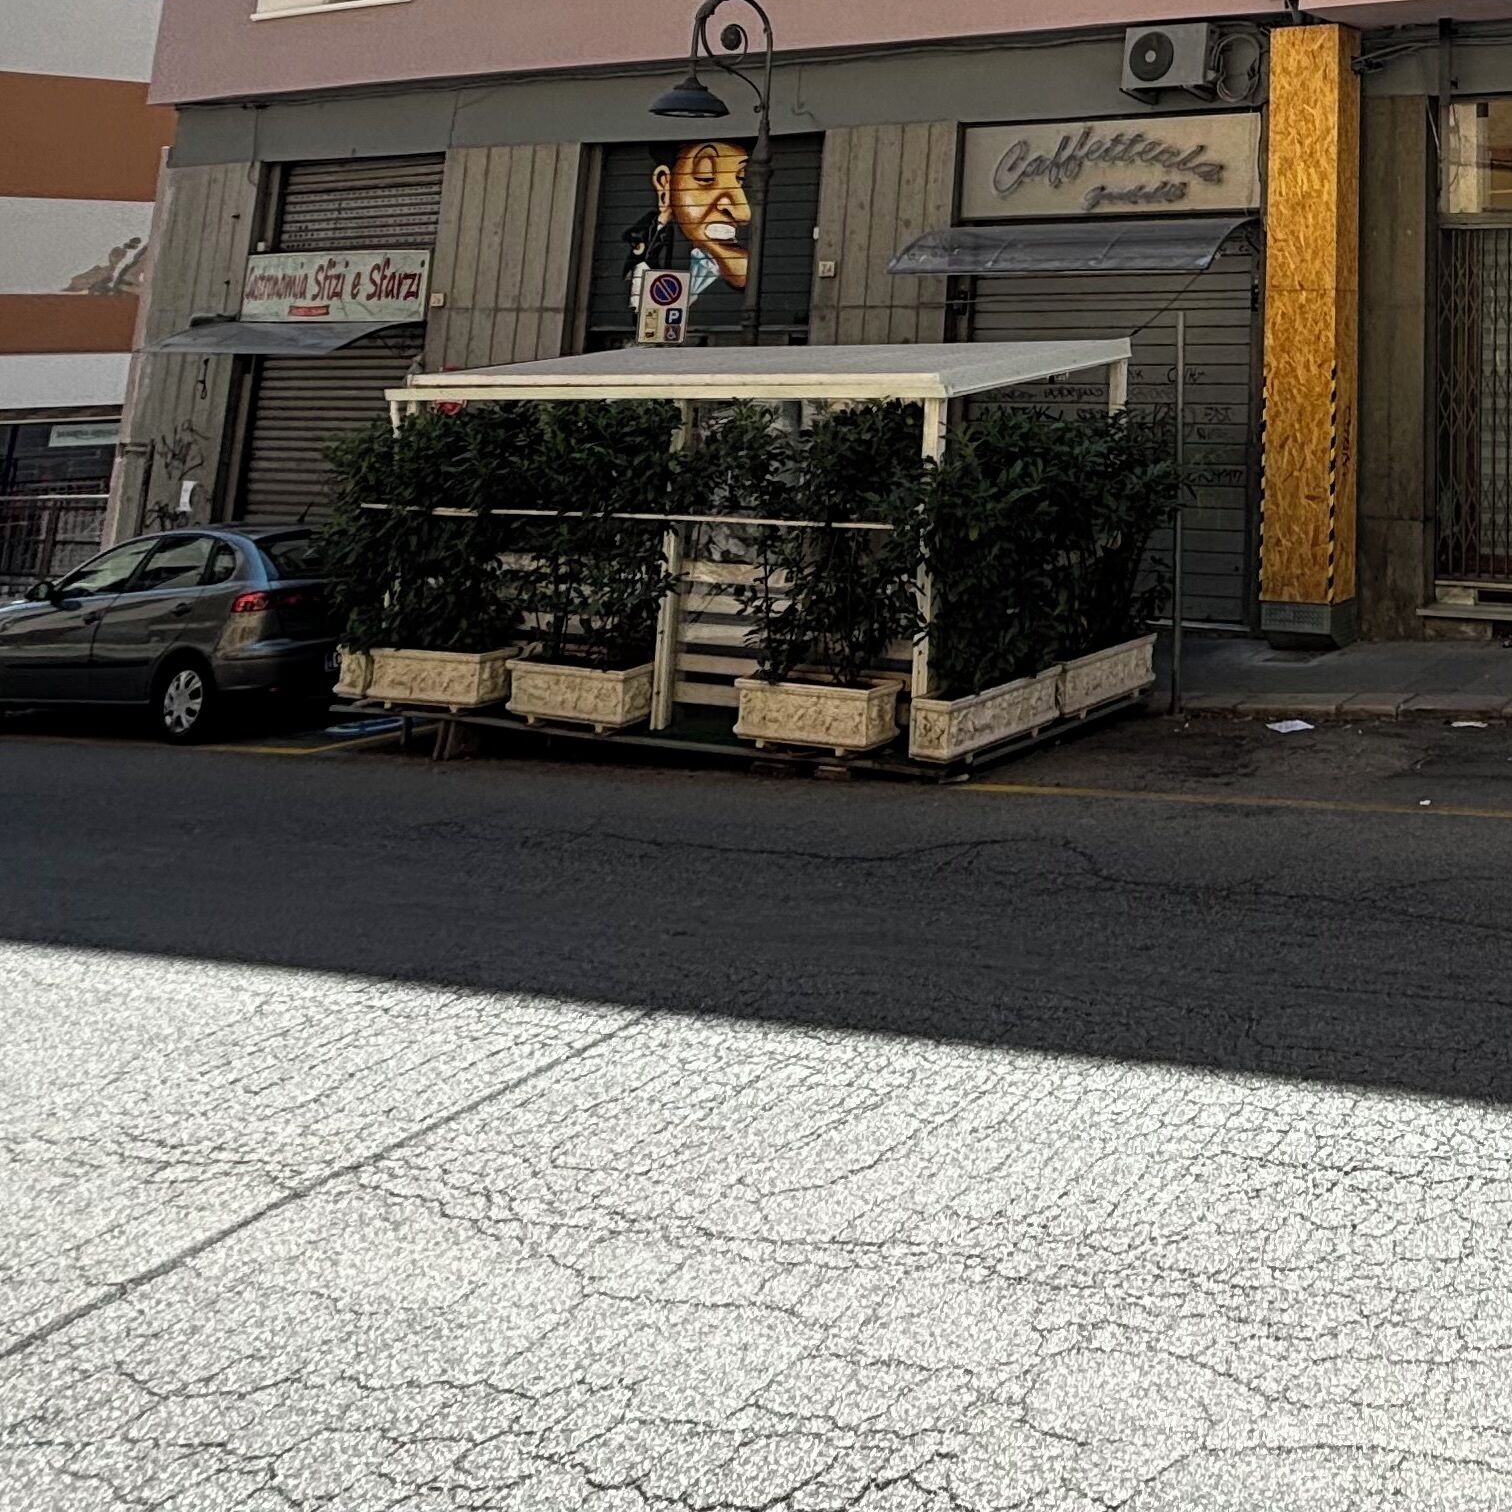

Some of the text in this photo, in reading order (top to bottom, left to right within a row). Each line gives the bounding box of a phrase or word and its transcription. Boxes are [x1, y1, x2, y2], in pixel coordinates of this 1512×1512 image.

[312, 258, 350, 301] Sfizi
[350, 271, 361, 300] e
[366, 257, 426, 301] Sfarzi
[668, 310, 680, 324] P
